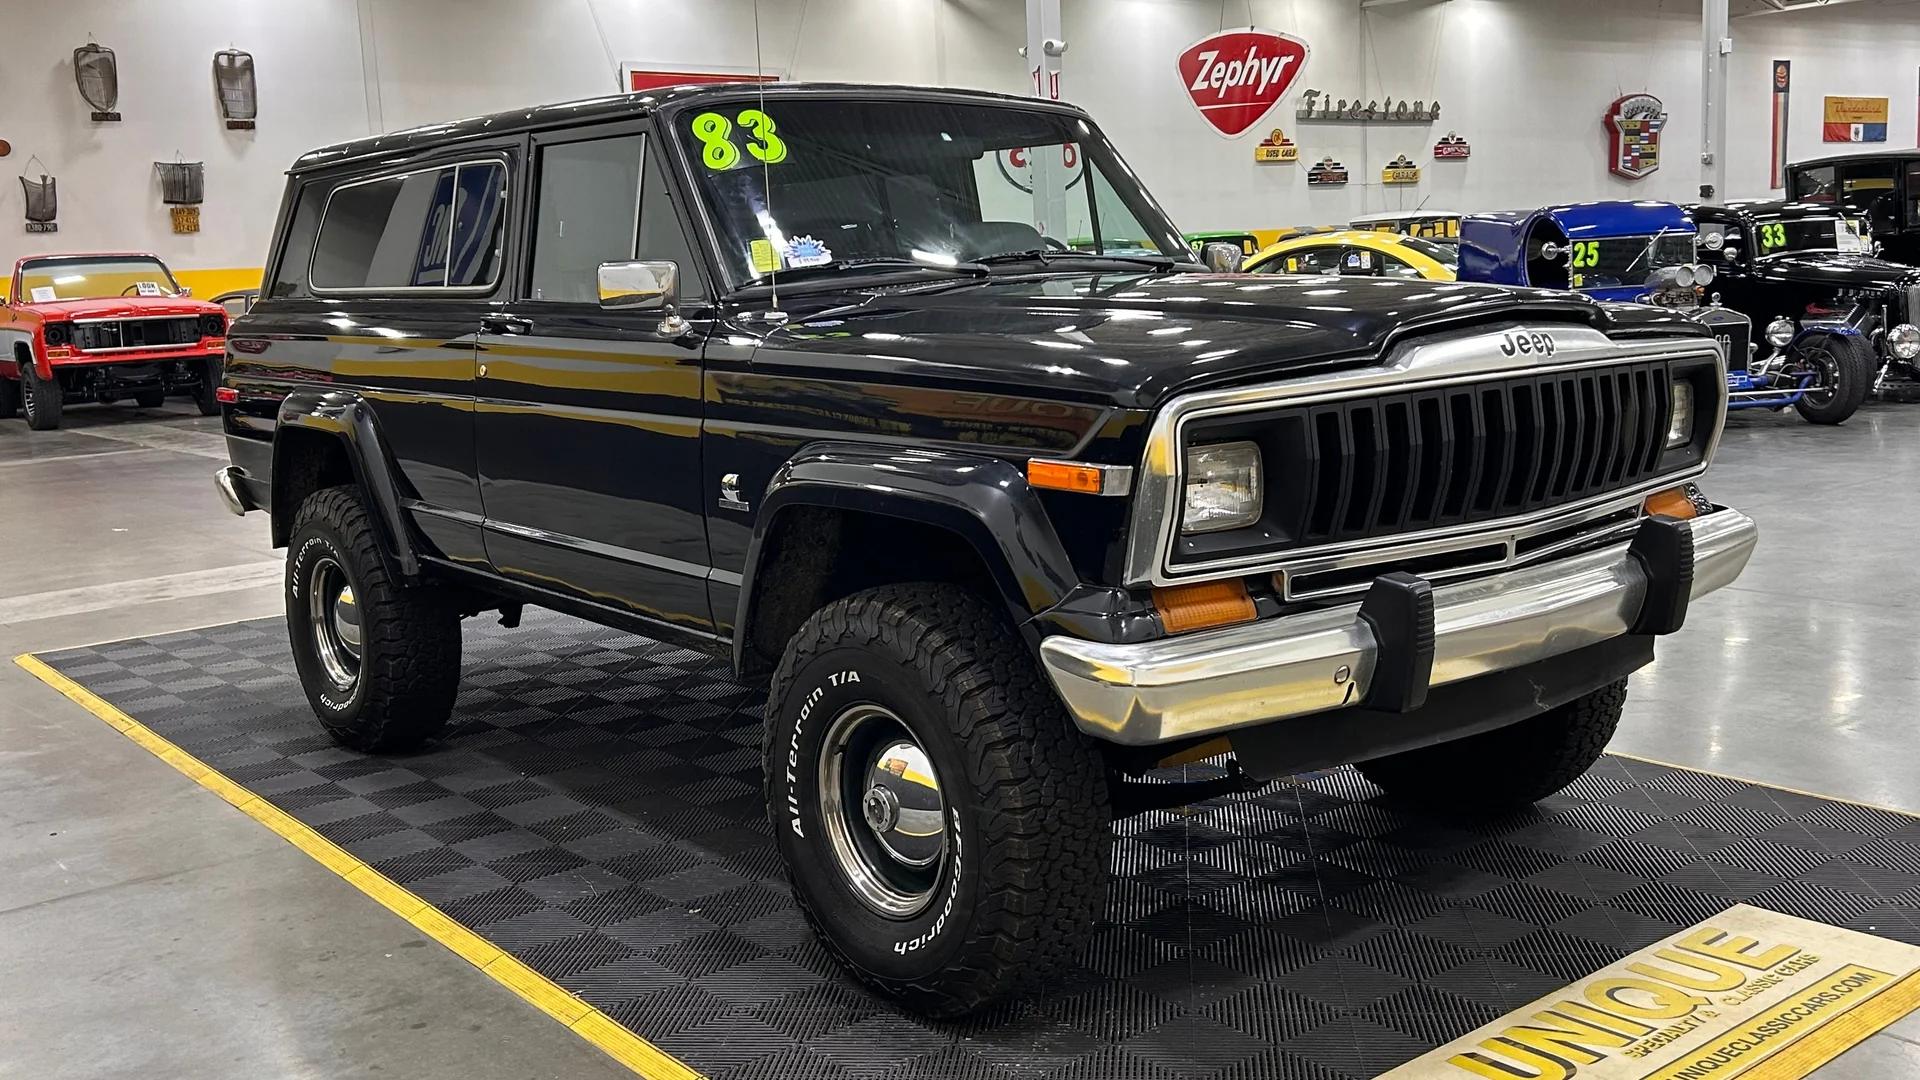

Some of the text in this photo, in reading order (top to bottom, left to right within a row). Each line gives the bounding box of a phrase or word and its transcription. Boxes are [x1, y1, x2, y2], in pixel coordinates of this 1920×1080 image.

[1190, 46, 1295, 99] Zephyr
[1302, 88, 1441, 122] Firestone
[691, 109, 788, 171] 83
[1190, 240, 1204, 251] 67
[1573, 241, 1600, 268] 25
[1761, 223, 1786, 248] 33
[1500, 333, 1555, 357] Jeep
[292, 537, 323, 599] All-Terrain
[785, 670, 862, 839] All-Terrain T/A
[893, 806, 963, 956] BFGoodrich
[1447, 927, 1803, 1080] UNIQUE
[1621, 1014, 1707, 1060] SPECIALTY
[1721, 972, 1784, 1006] CLASSIC
[1778, 953, 1821, 978] CARS
